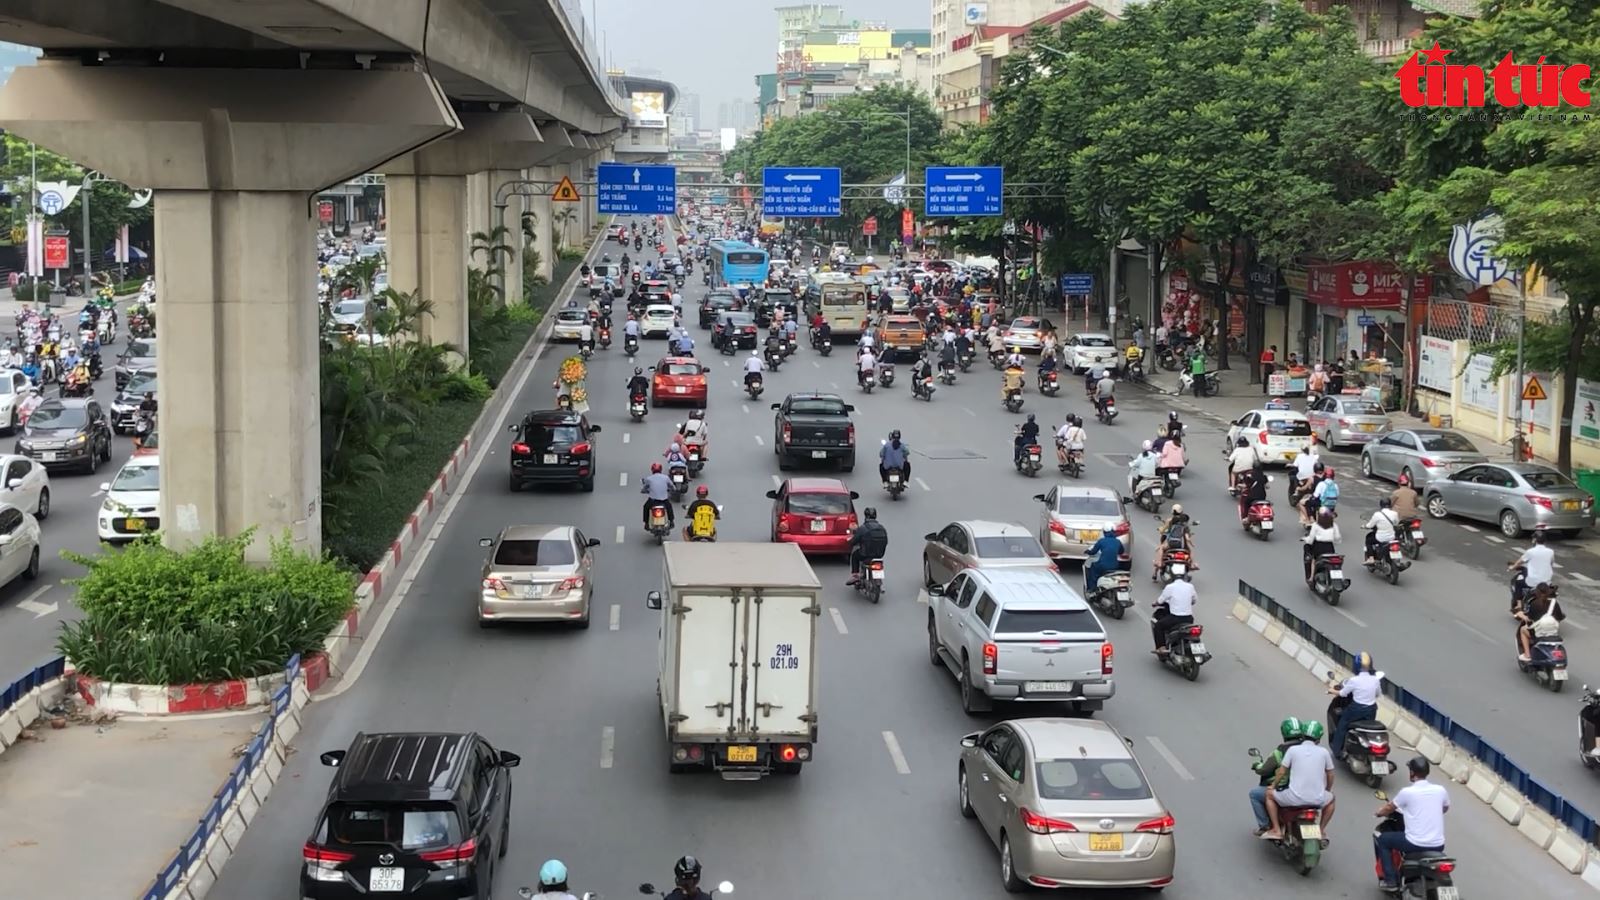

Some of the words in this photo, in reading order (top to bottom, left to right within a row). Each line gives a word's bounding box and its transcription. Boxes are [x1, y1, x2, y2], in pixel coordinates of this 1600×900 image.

[1373, 273, 1425, 288] MIXE
[776, 644, 792, 656] 29H
[771, 657, 798, 669] 021.09
[379, 868, 396, 878] 30F
